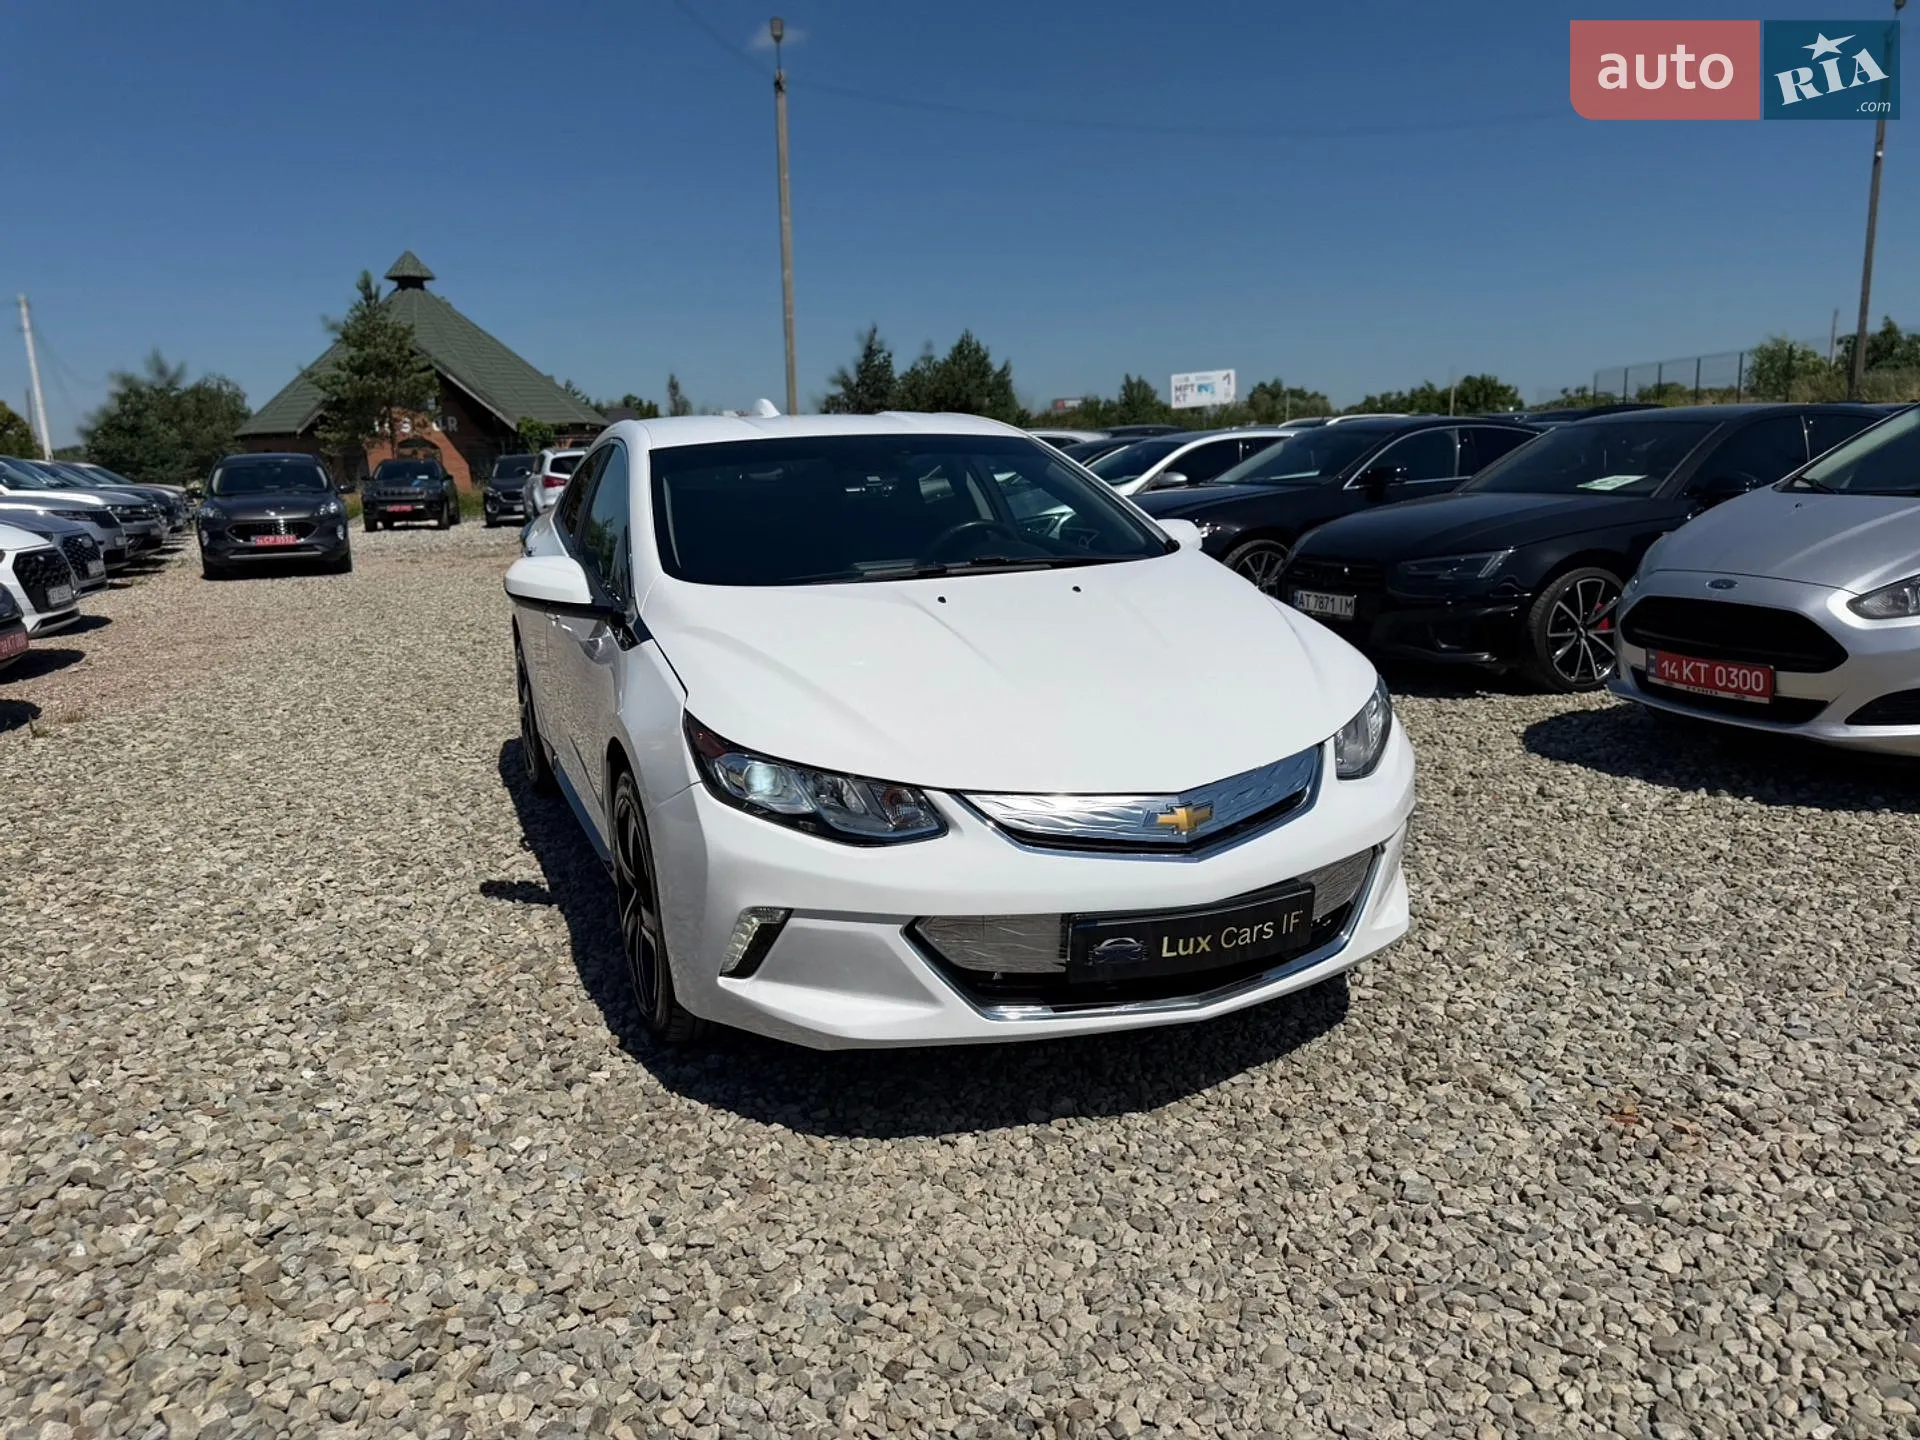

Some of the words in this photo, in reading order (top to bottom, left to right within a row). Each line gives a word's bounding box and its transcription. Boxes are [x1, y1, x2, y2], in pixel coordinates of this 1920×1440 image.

[1298, 592, 1312, 608] AT
[1314, 594, 1335, 612] 7871
[1340, 598, 1353, 614] IM
[1715, 666, 1764, 692] 0300
[1161, 934, 1212, 958] Lux
[1220, 919, 1273, 948] Cars
[1282, 909, 1303, 934] IF
